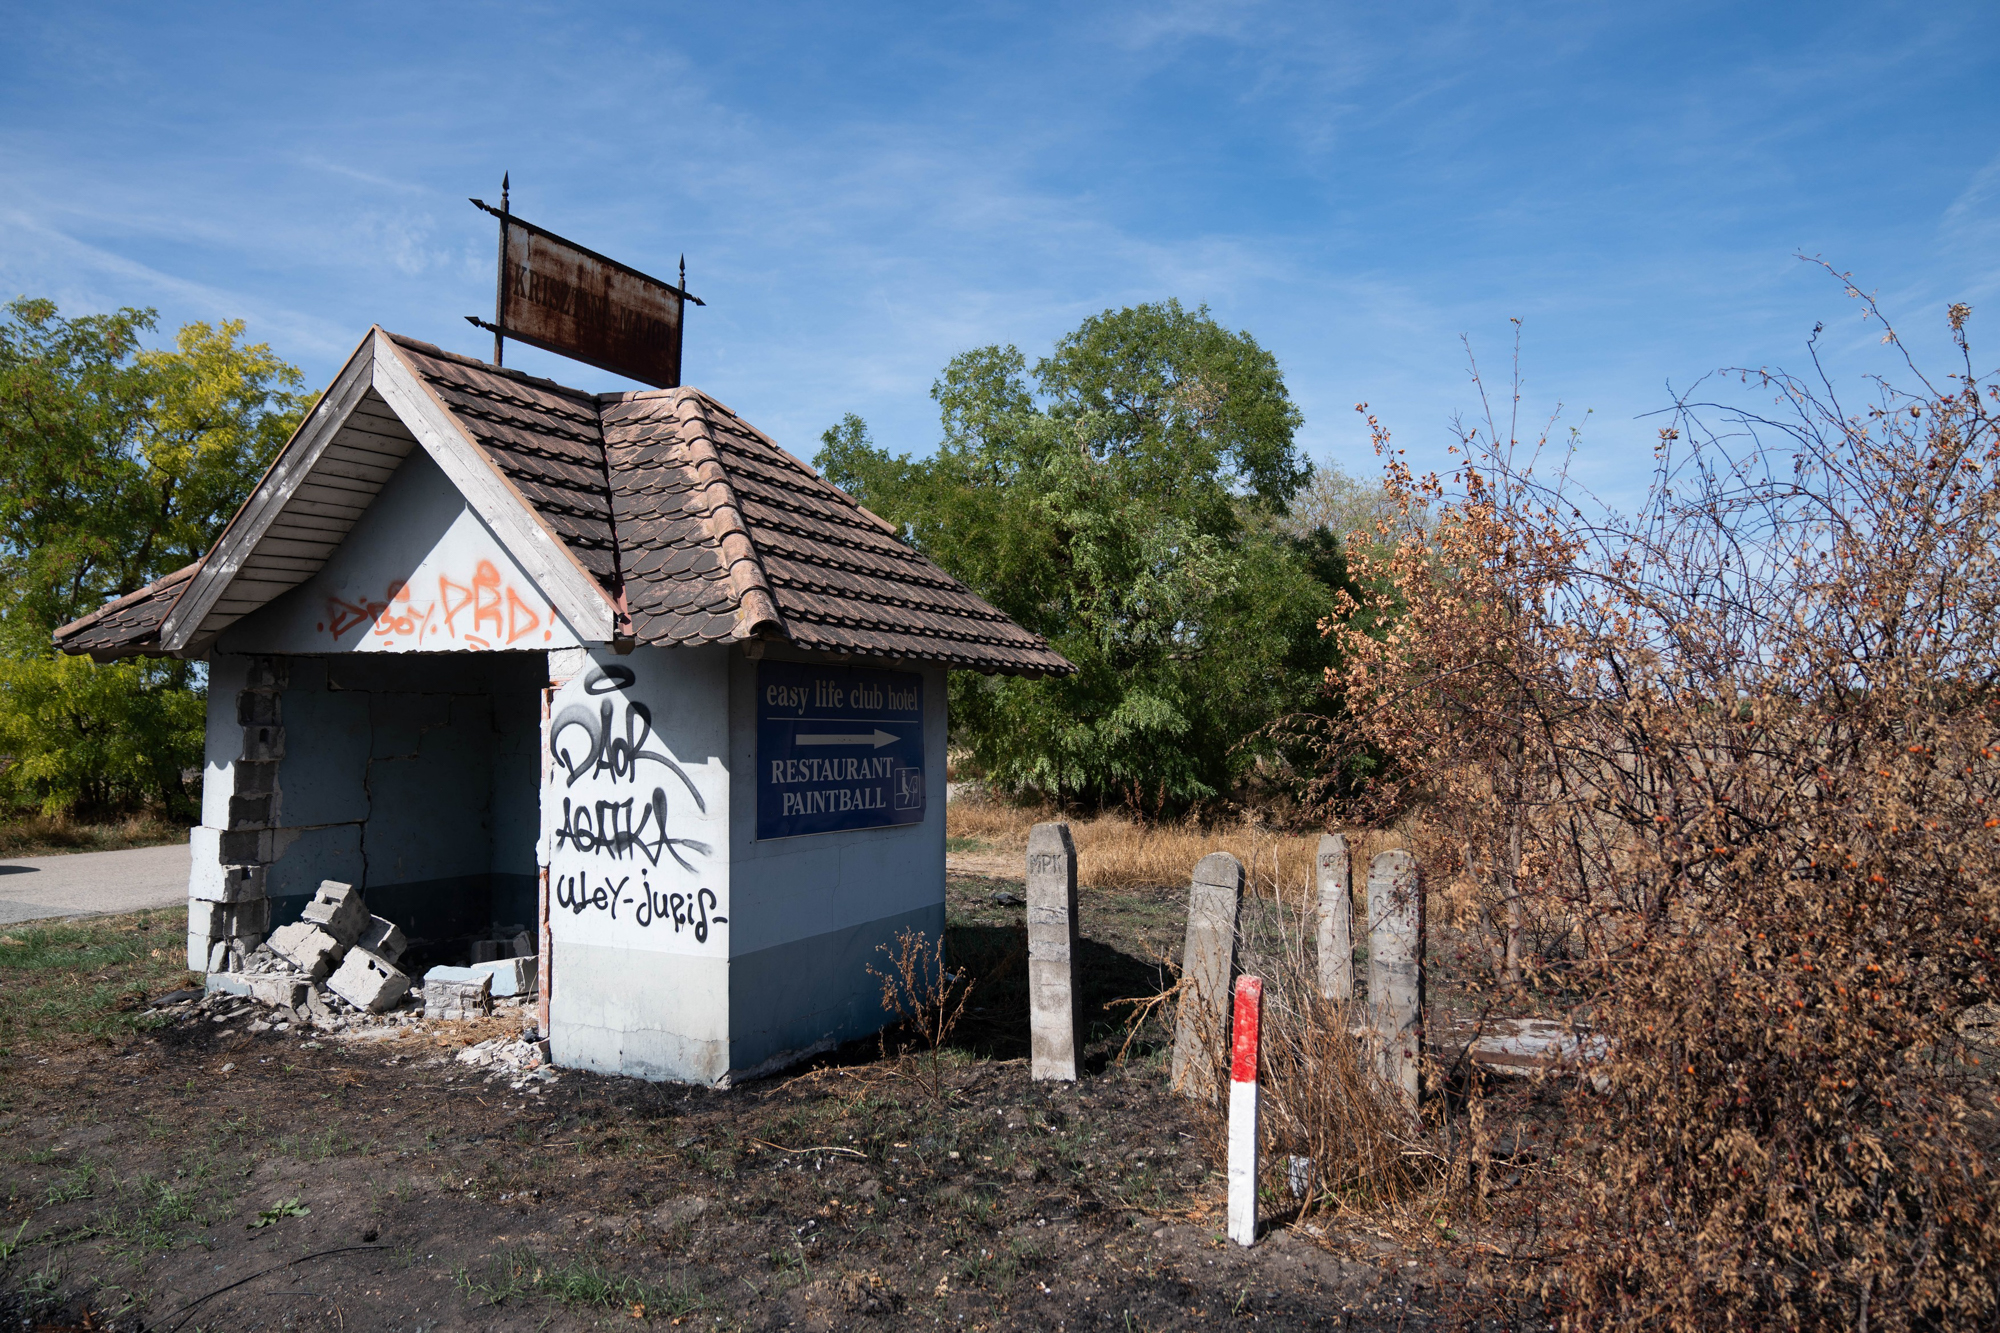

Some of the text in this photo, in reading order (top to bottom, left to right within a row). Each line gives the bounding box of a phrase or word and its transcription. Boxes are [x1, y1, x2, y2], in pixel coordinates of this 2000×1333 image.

[766, 680, 919, 716] easy life club hotel
[771, 756, 894, 784] RESTAURANT
[782, 787, 887, 817] PAINTBALL
